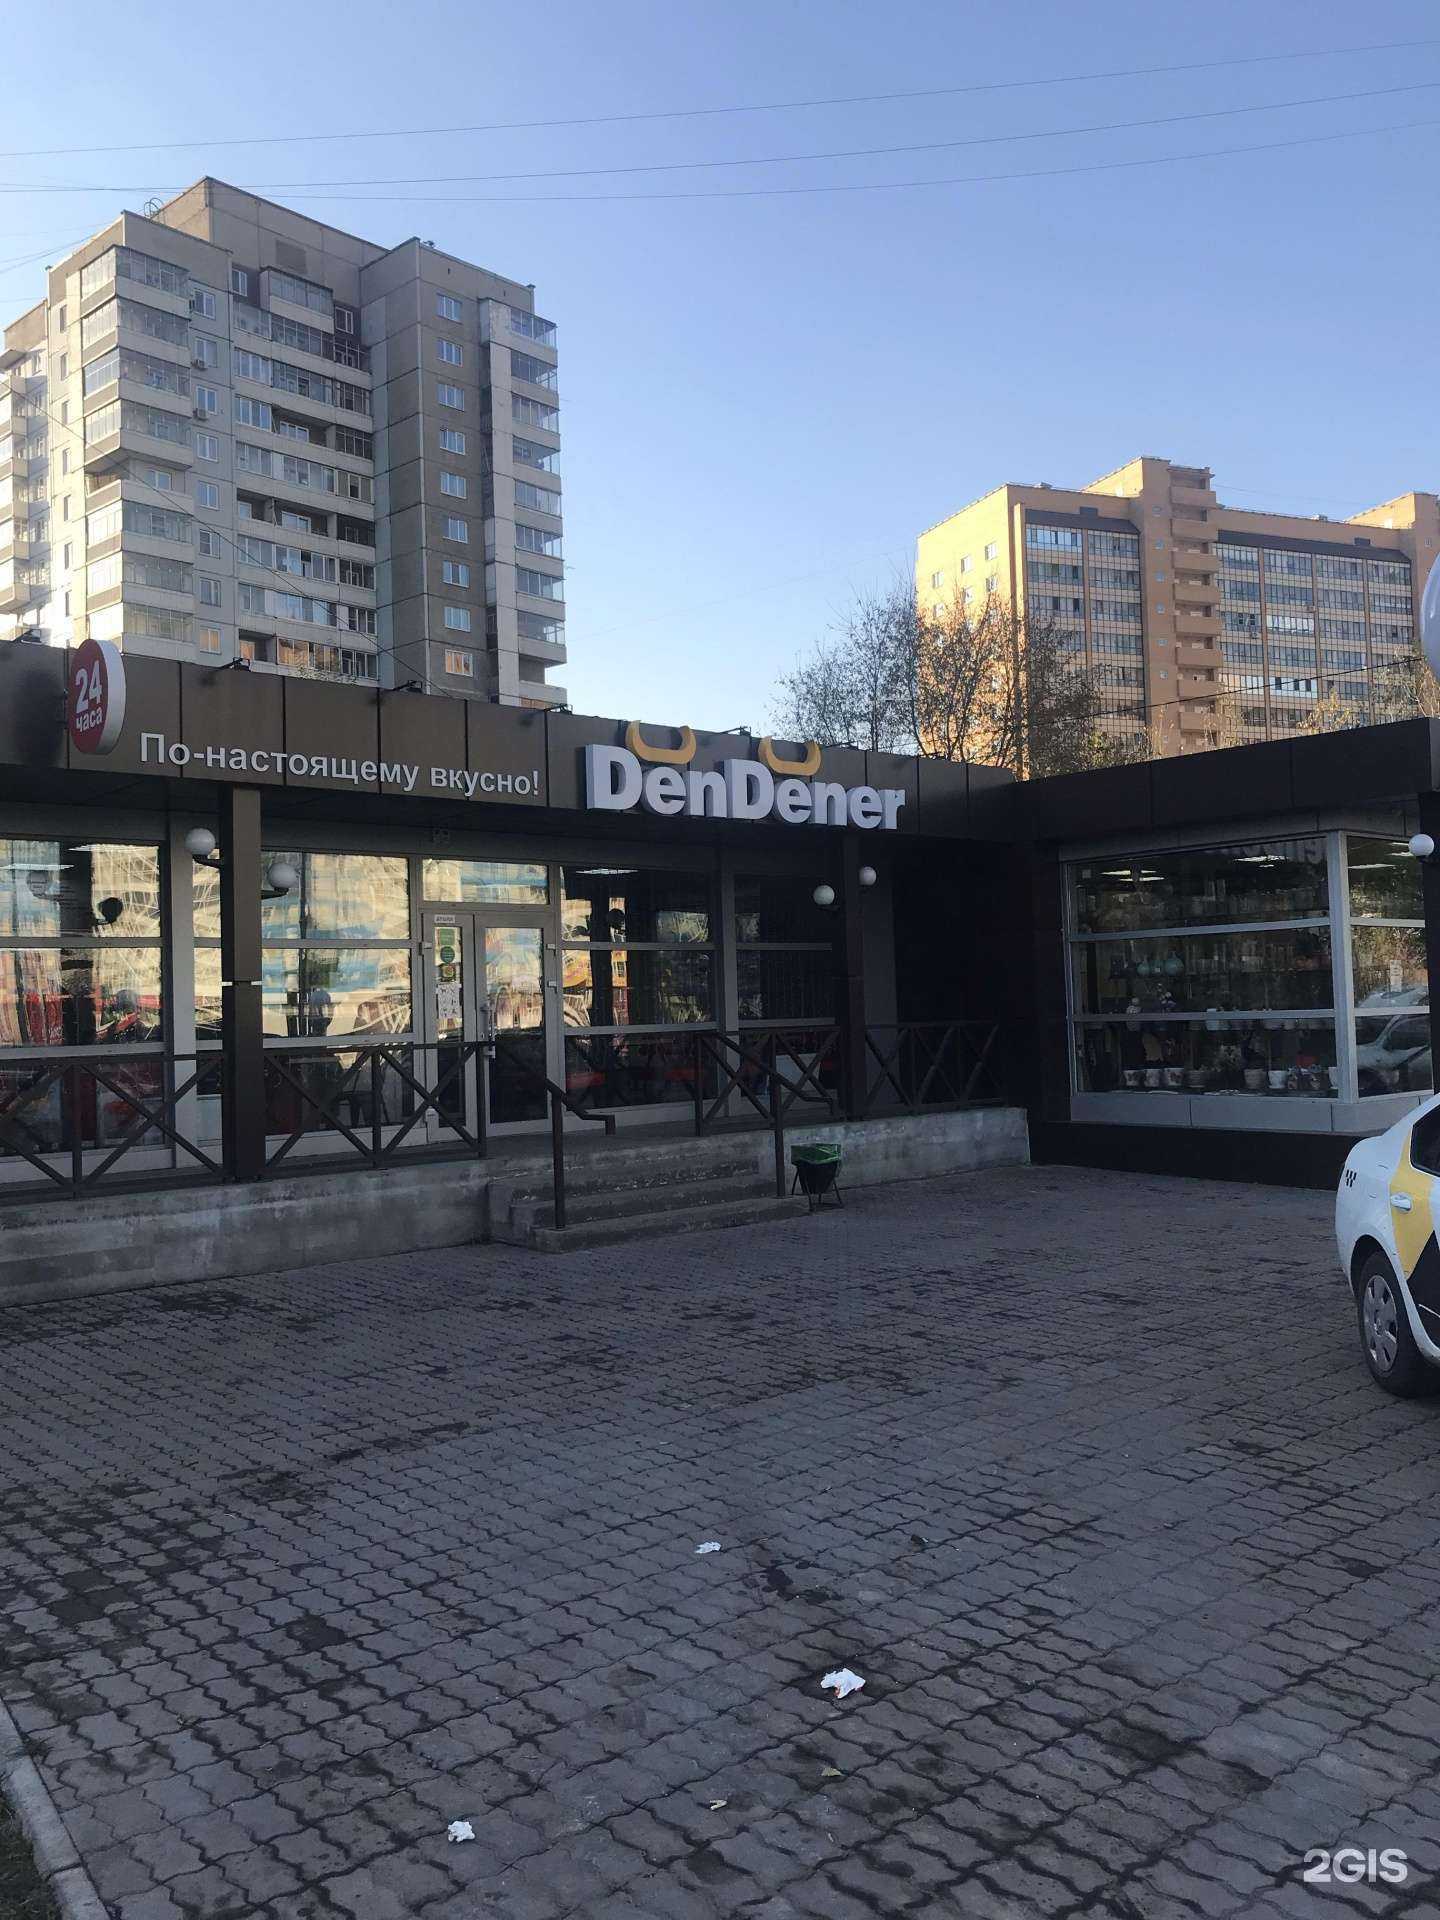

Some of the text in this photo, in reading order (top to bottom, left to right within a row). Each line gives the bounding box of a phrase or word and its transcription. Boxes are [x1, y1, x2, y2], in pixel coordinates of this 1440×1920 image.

[75, 660, 103, 714] 24
[75, 707, 103, 733] часа
[140, 732, 539, 798] По-настоящему вкусно!
[585, 743, 906, 830] DenDener
